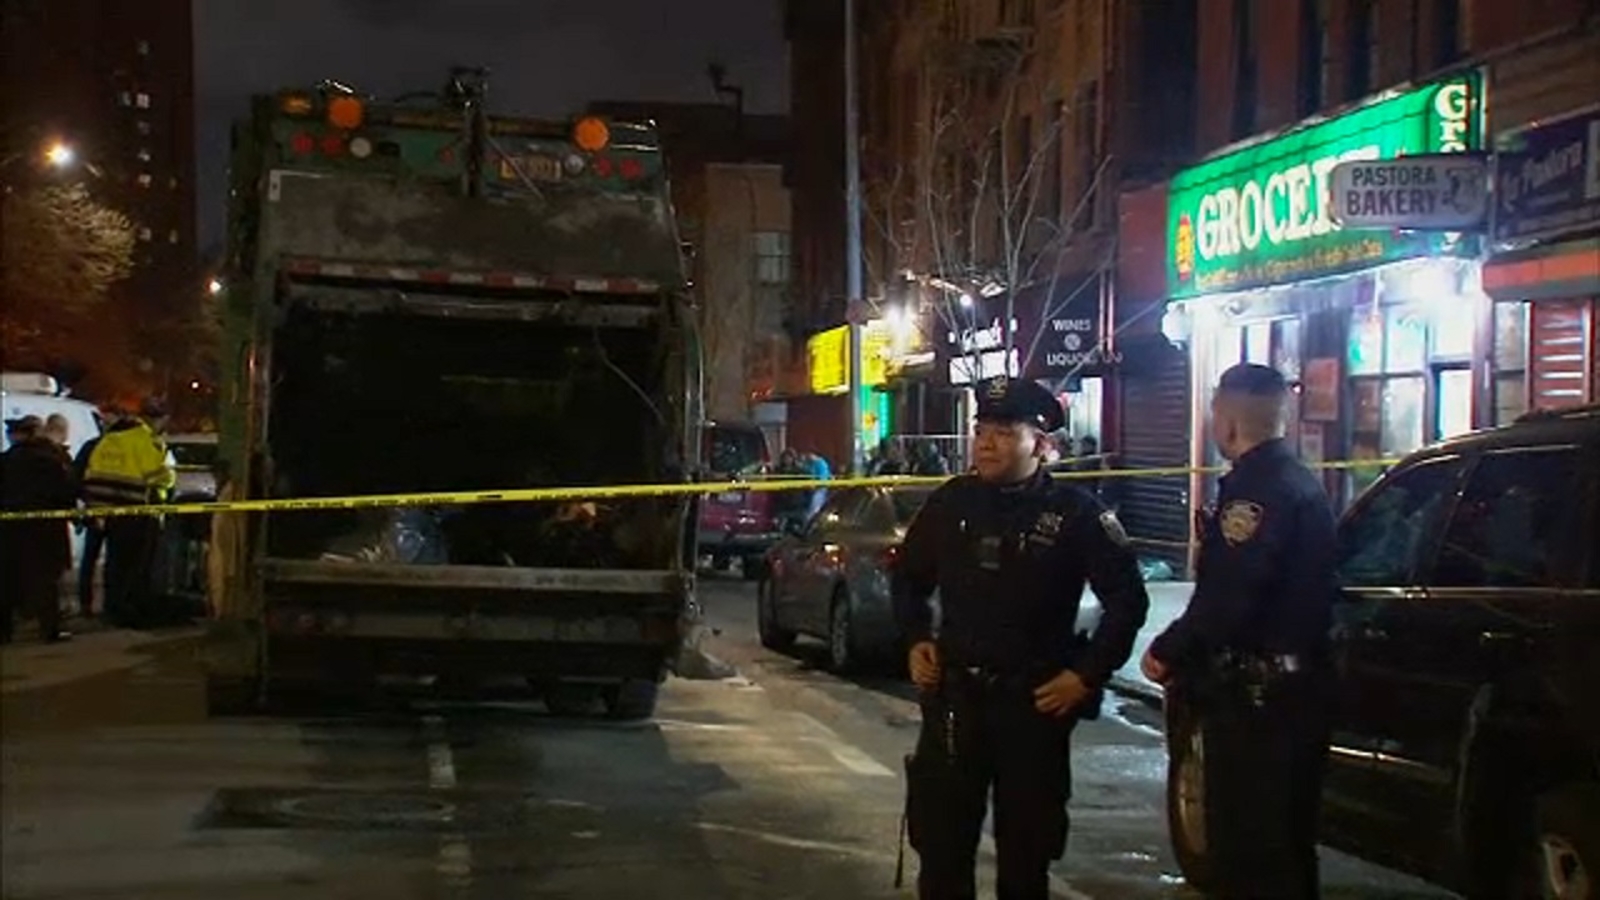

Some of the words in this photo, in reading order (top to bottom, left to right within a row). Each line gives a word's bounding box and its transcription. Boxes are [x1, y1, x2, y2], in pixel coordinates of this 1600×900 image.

[1351, 166, 1437, 187] PASTORA
[1197, 145, 1380, 260] GROCER
[1346, 188, 1440, 216] BAKERY
[1052, 319, 1091, 332] WINES
